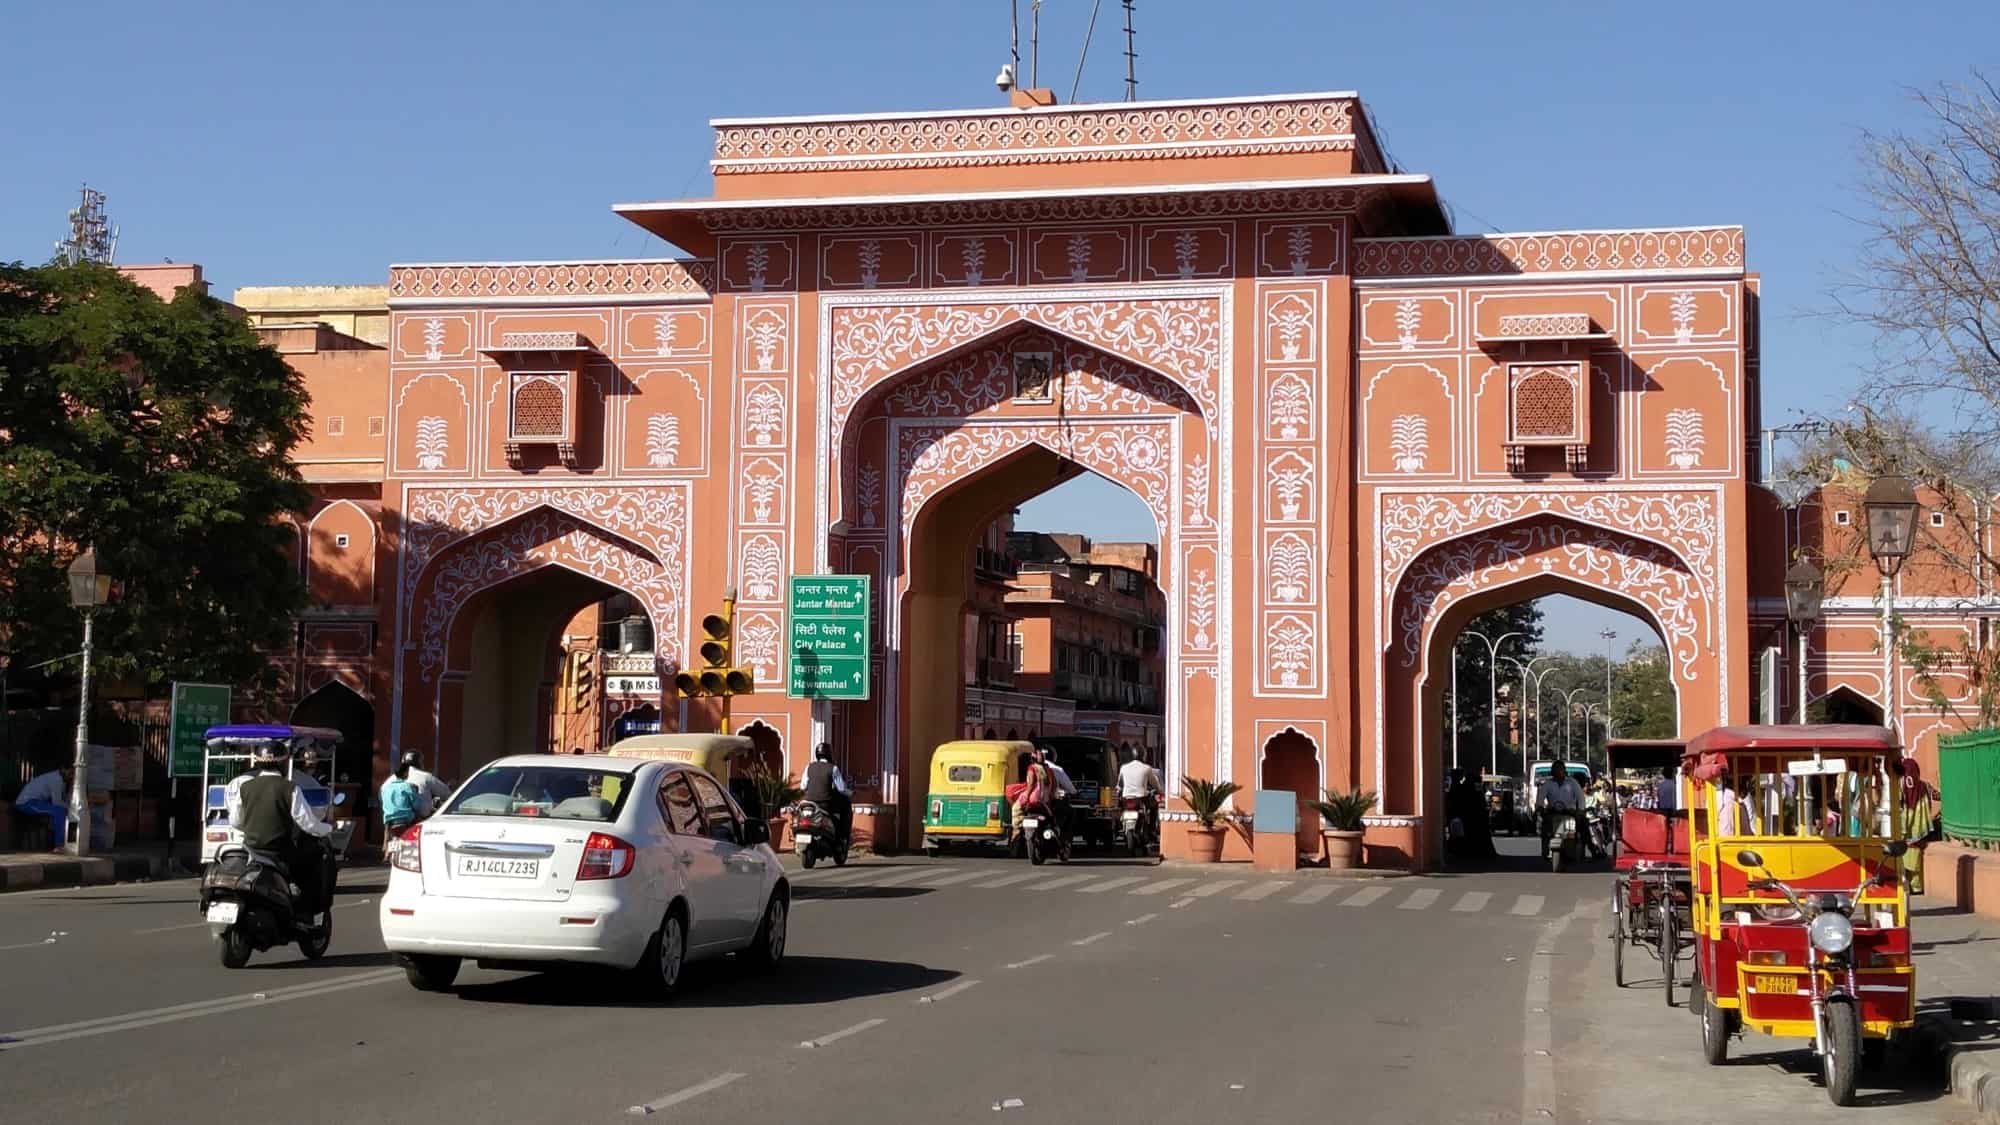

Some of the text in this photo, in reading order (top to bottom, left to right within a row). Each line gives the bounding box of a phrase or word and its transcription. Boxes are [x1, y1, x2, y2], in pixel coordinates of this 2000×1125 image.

[795, 600, 855, 609] Jantar Mantar
[795, 622, 817, 635] सिटी
[795, 640, 846, 650] City Palace
[793, 680, 847, 689] Hawamahal
[465, 861, 536, 874] RJ14CL7235
